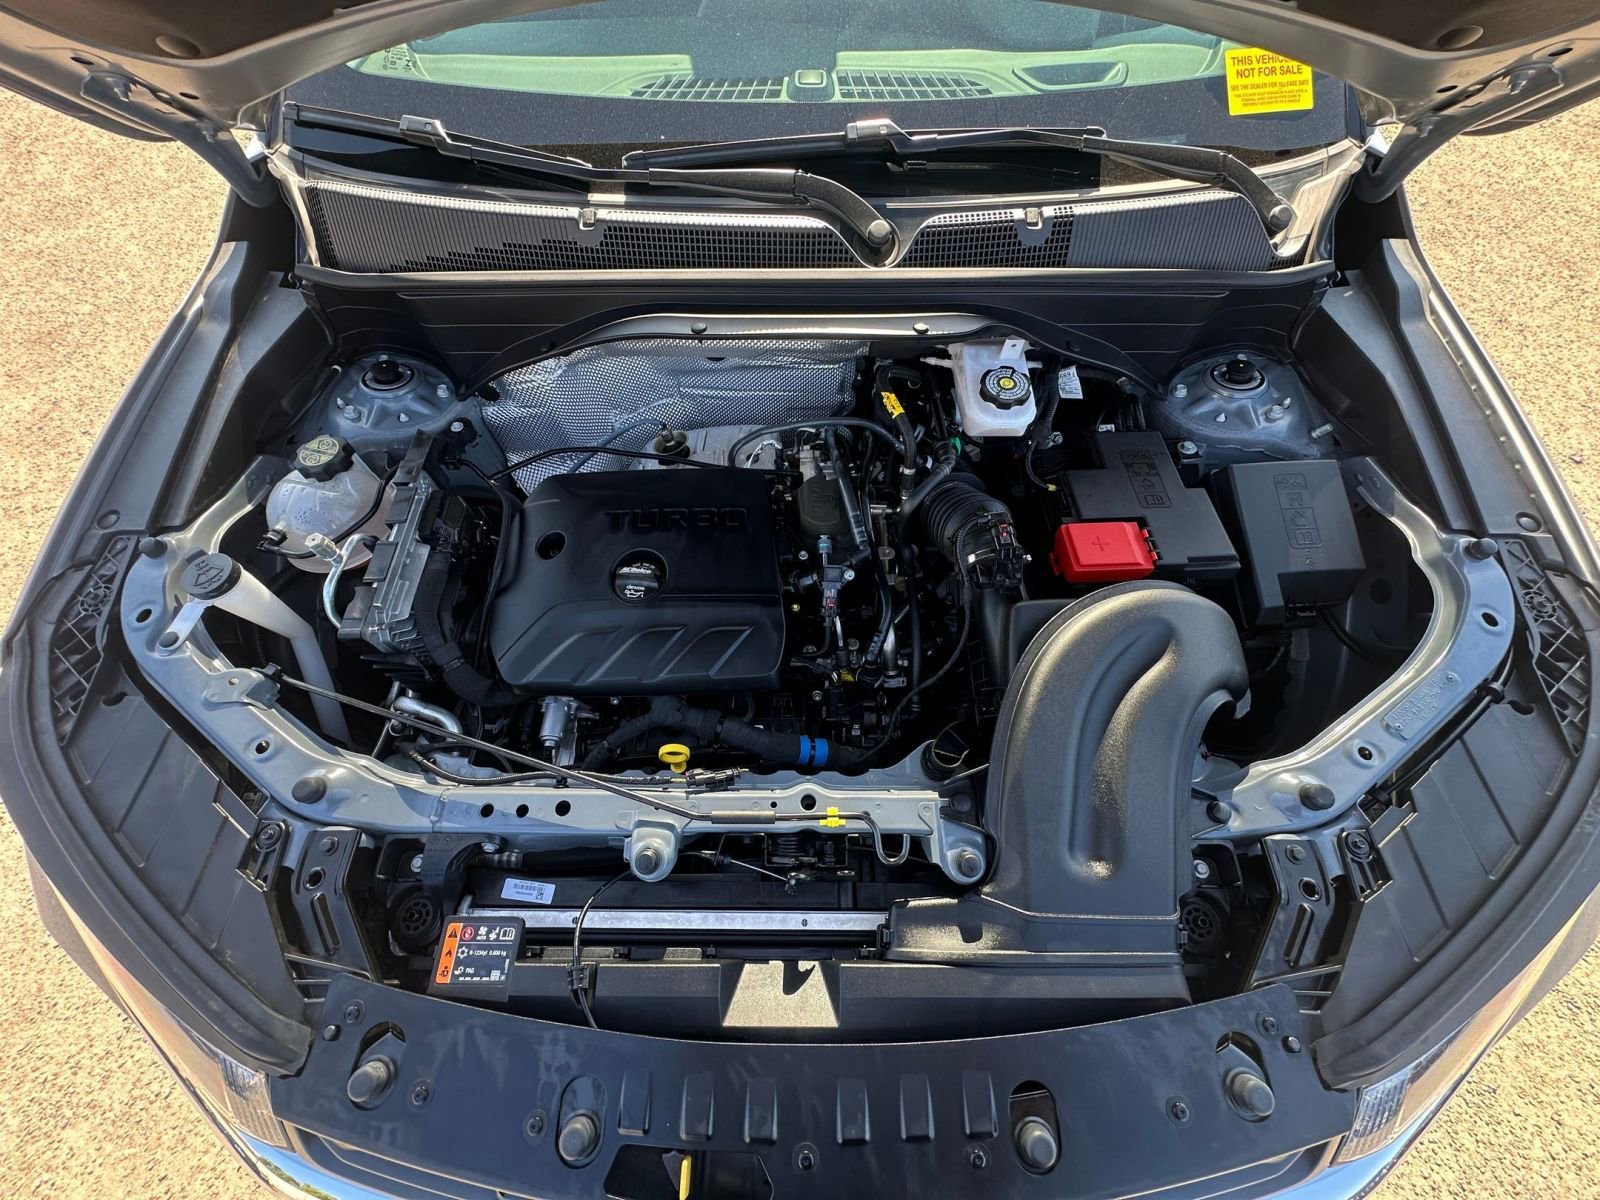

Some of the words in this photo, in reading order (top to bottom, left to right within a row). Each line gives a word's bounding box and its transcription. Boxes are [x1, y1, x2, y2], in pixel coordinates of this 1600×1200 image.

[1230, 56, 1253, 67] THIS
[1255, 54, 1292, 65] VEHIC
[1236, 68, 1256, 79] NOT
[1258, 66, 1277, 77] FOR
[1279, 65, 1303, 76] SALE
[1230, 84, 1239, 92] SEE
[1250, 82, 1268, 90] DEALER
[604, 507, 748, 530] TURBO
[617, 566, 652, 575] ACDelco
